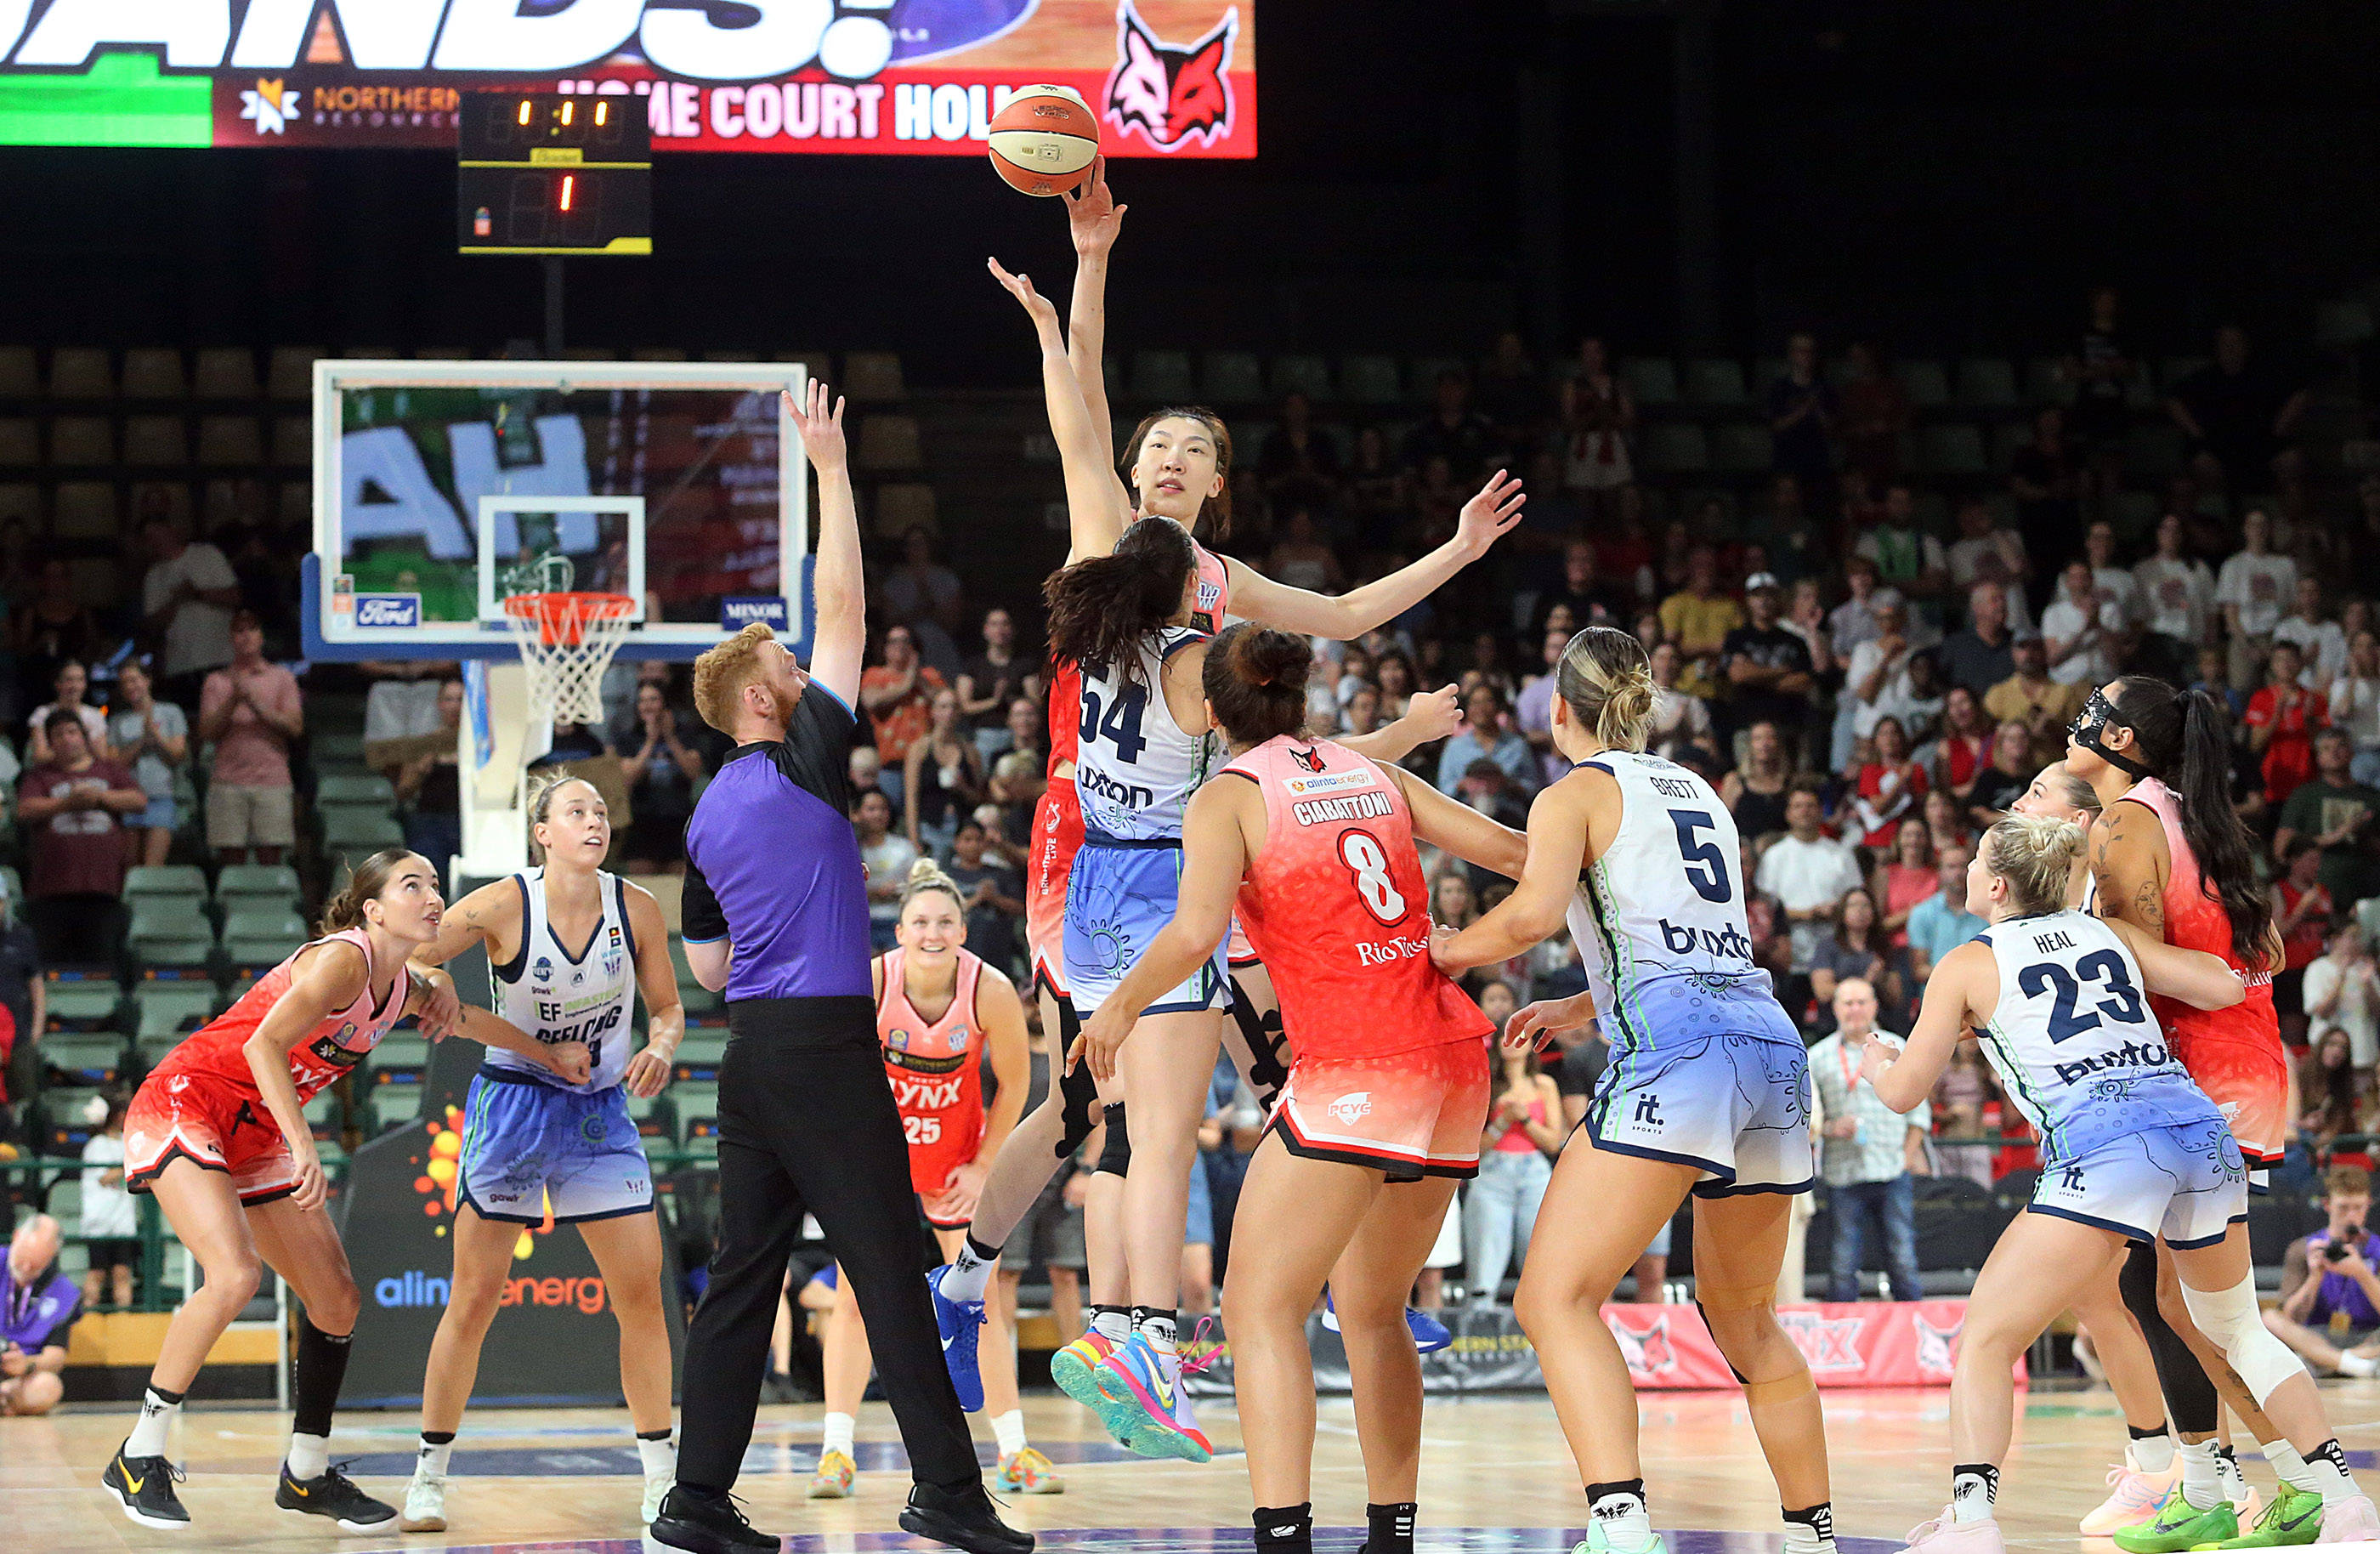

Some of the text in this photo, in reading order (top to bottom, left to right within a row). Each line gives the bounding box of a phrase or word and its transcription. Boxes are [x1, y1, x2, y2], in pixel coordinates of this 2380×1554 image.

[710, 83, 885, 140] COURT
[359, 600, 415, 626] Ford
[1650, 776, 1699, 800] BRETT
[1292, 791, 1394, 827] CIABATTONI
[1667, 808, 1732, 904] 5
[1338, 828, 1409, 927] 8
[1658, 918, 1754, 961] buxto
[2033, 930, 2078, 954] HEAL
[2018, 949, 2146, 1045] 23
[2054, 1040, 2176, 1086] buxto
[1328, 1103, 1372, 1116] PCYC
[904, 1115, 942, 1145] 25
